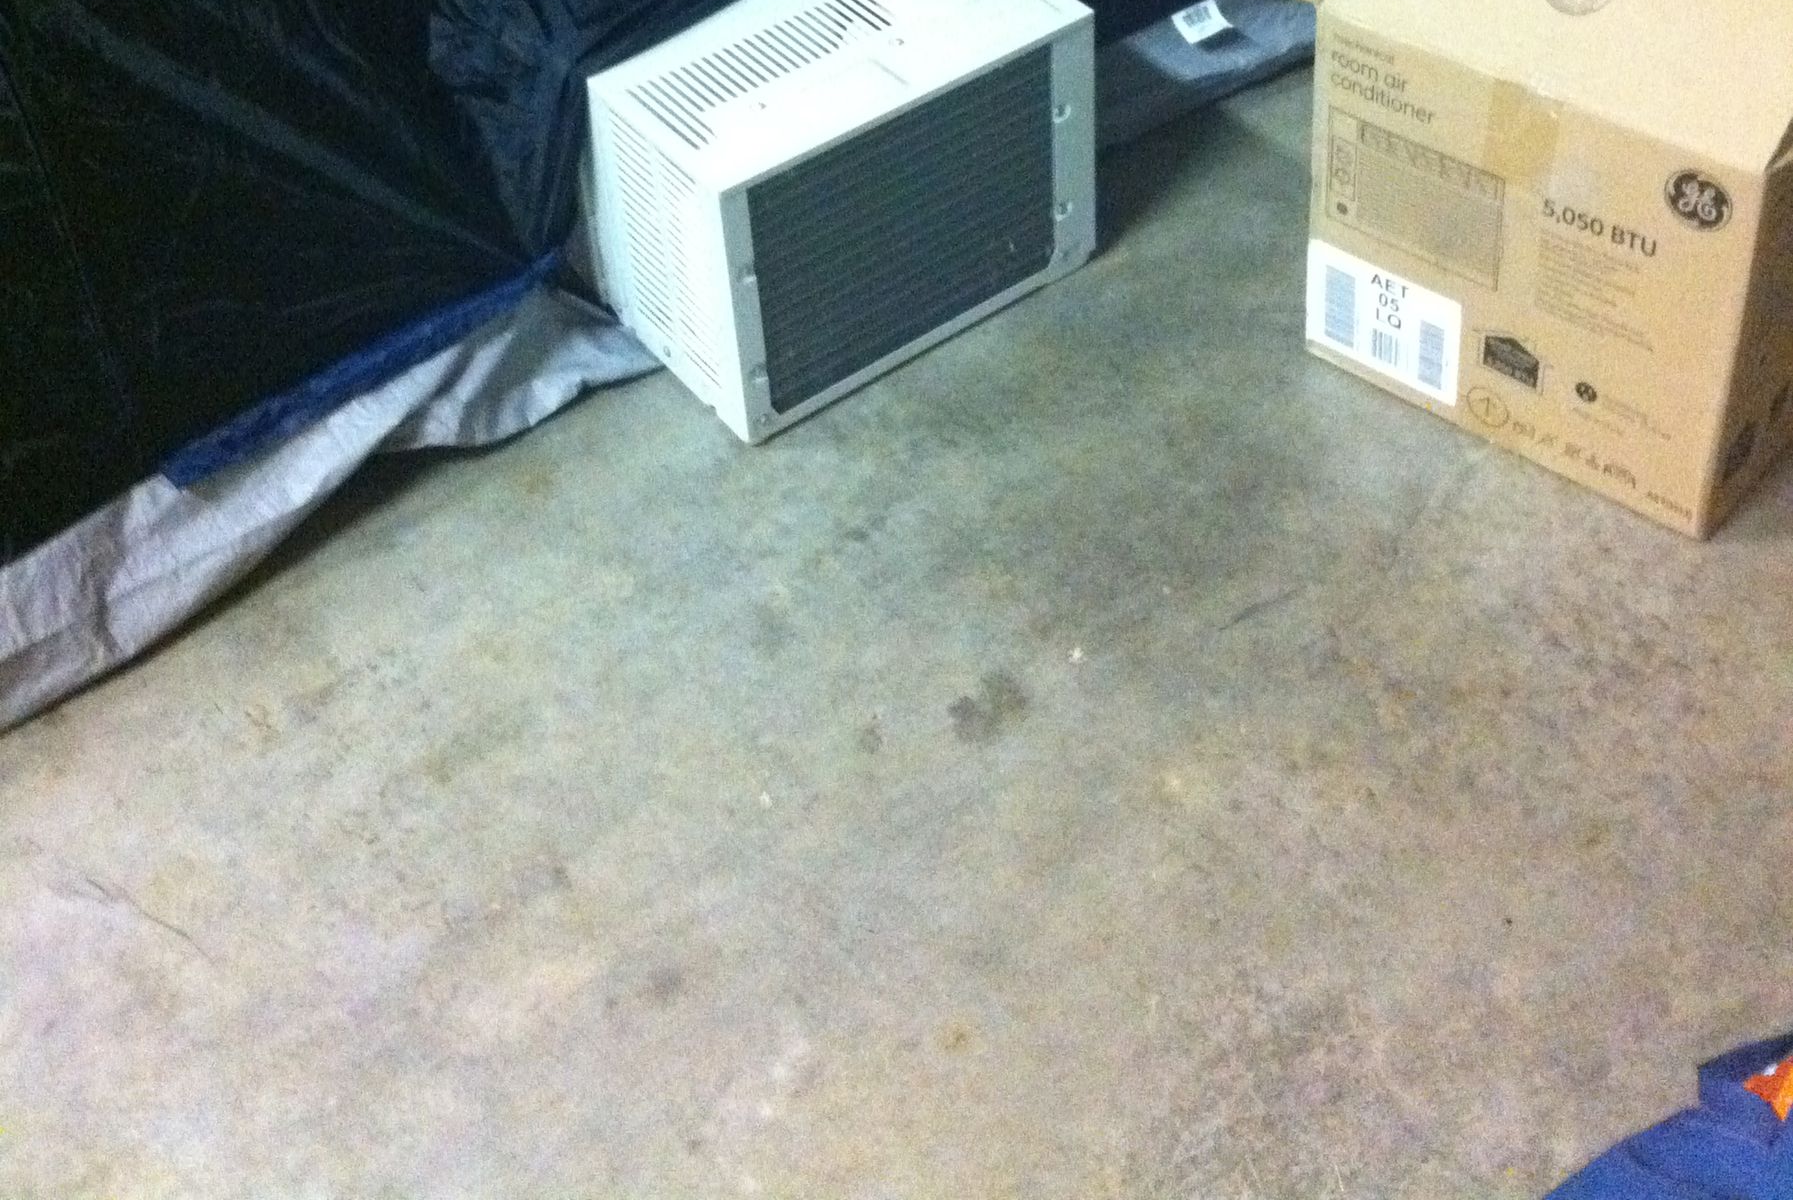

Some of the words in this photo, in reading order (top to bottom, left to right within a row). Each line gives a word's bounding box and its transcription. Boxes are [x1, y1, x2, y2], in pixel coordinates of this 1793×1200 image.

[1331, 51, 1379, 82] room
[1384, 72, 1408, 92] air
[1330, 73, 1436, 124] conditioner
[1666, 169, 1733, 232] GE
[1543, 199, 1604, 236] 5,050
[1610, 224, 1657, 258] BTU
[1370, 273, 1409, 299] AET
